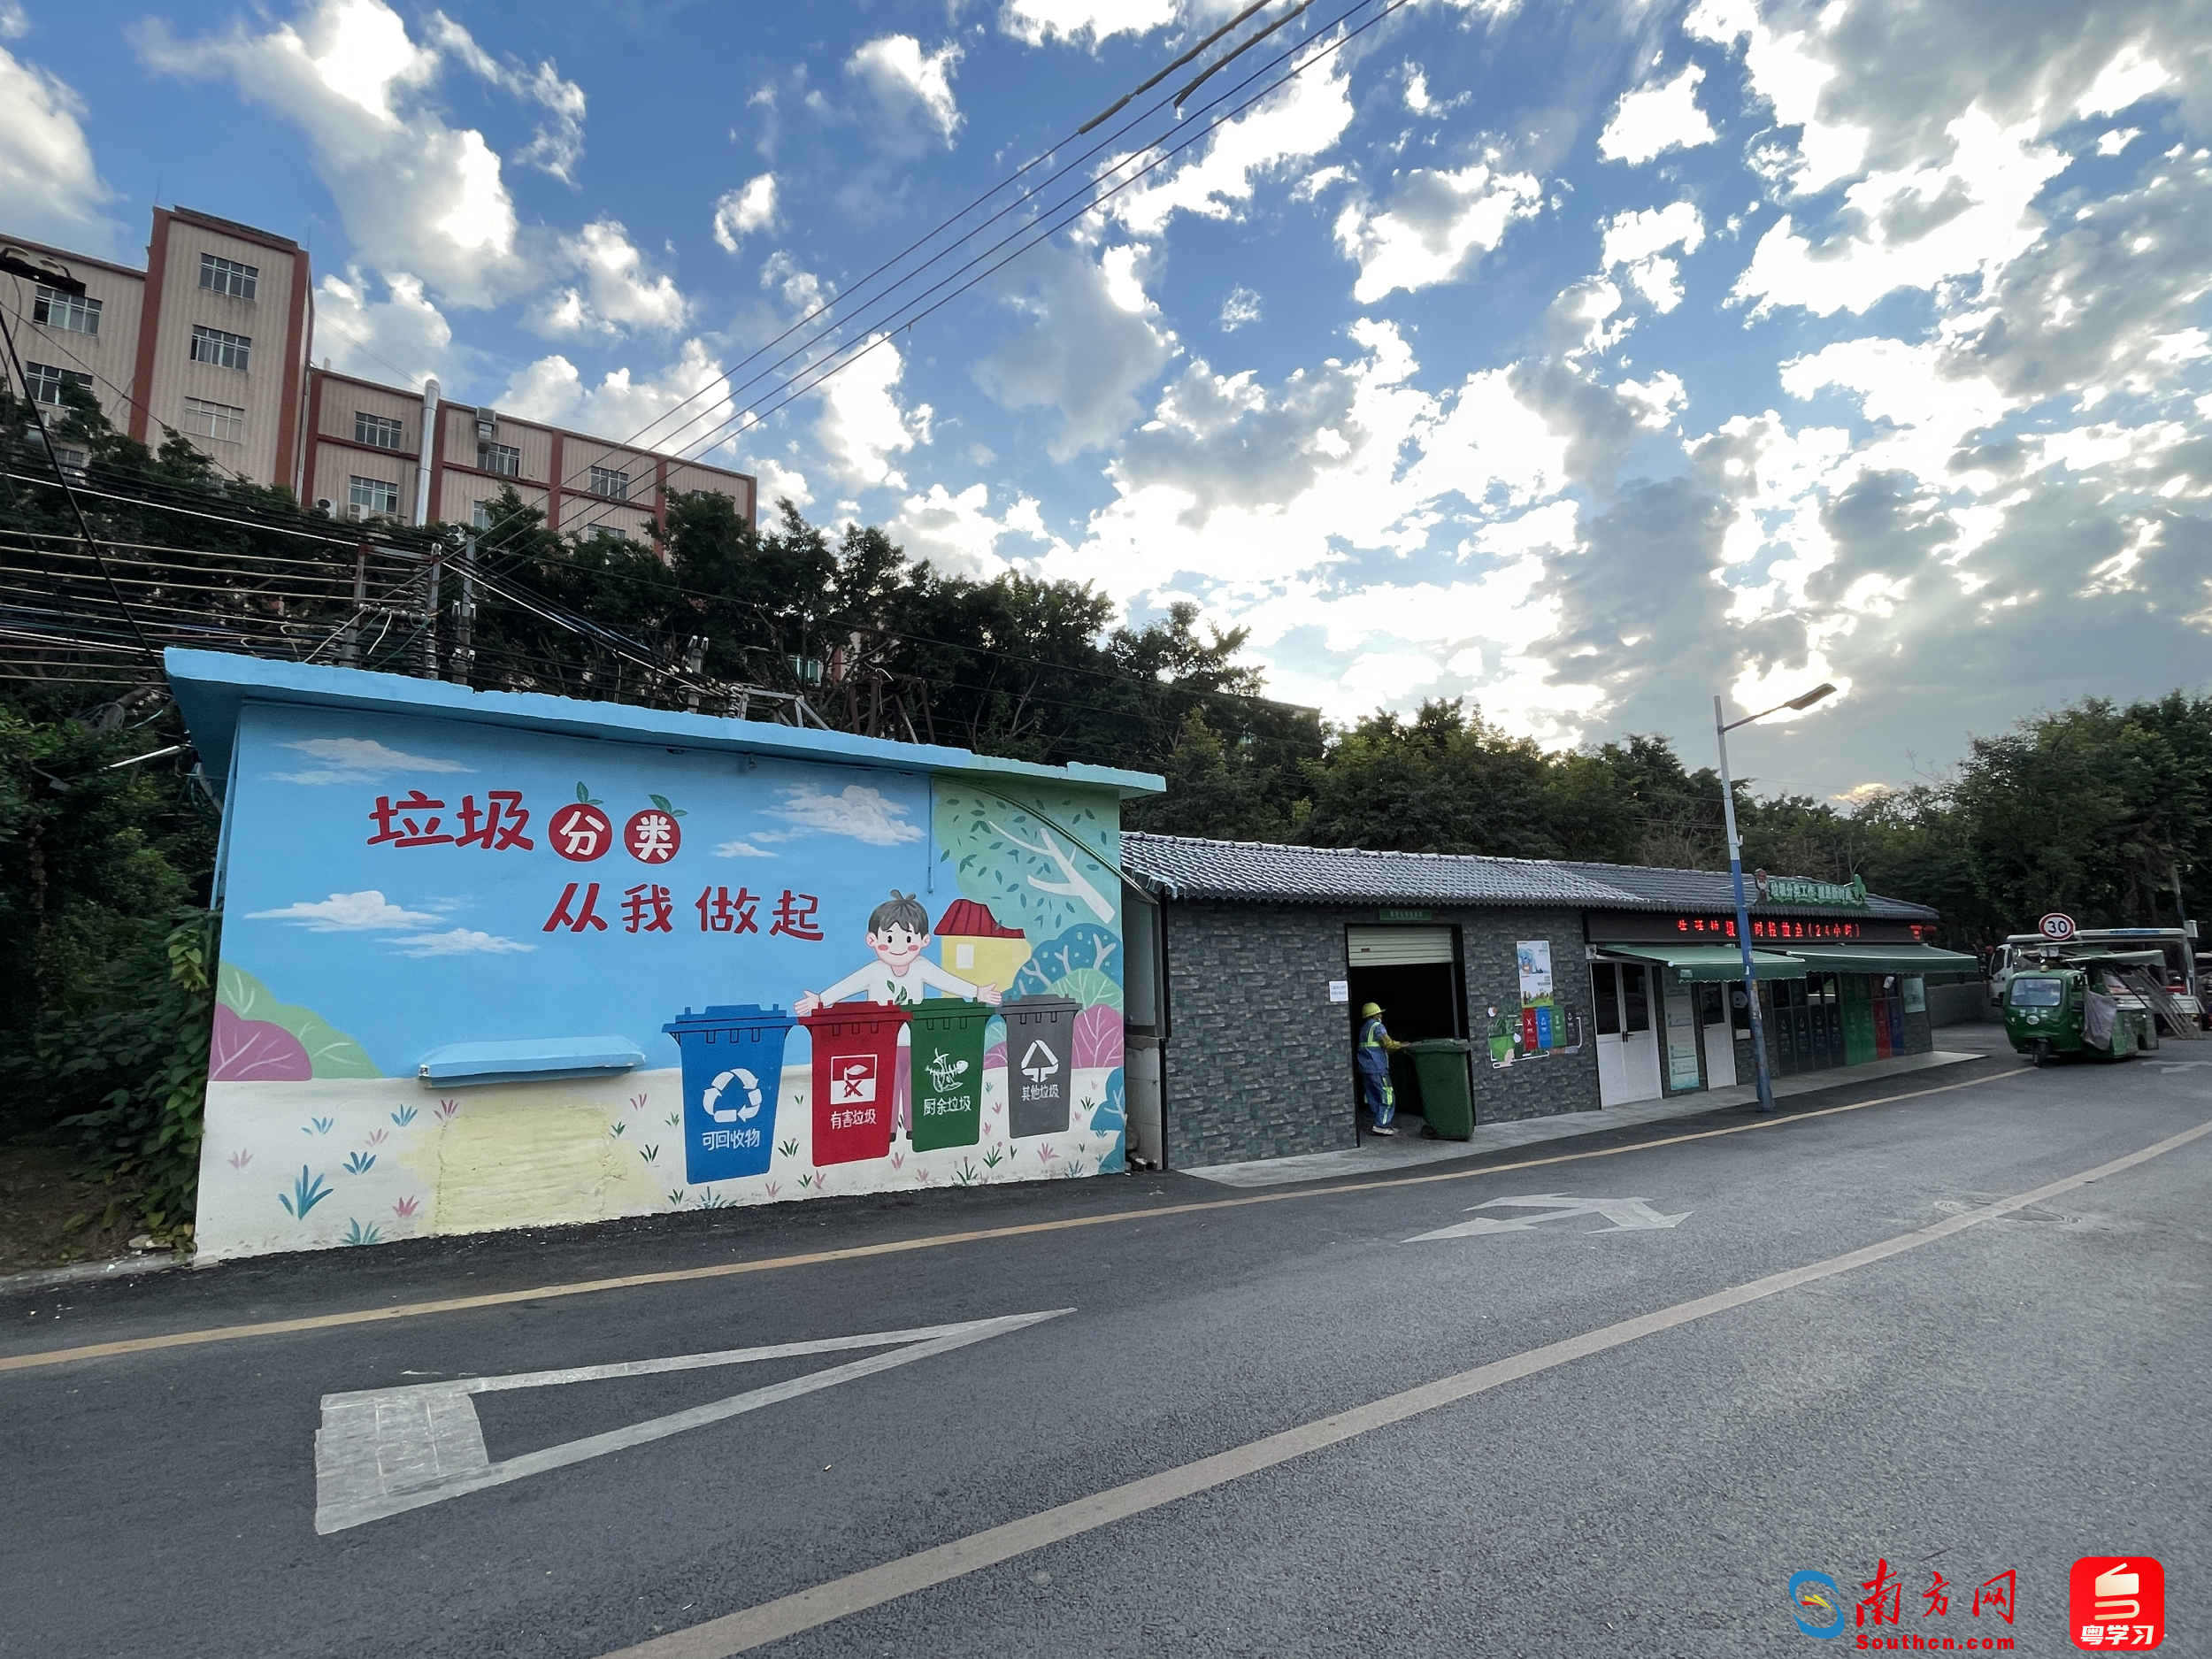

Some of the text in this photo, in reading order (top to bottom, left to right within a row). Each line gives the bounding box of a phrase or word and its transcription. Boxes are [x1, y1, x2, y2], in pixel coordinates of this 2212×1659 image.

[367, 789, 673, 861] 垃圾分类
[542, 882, 825, 941] 从我做起
[2047, 920, 2068, 934] 30
[1021, 1083, 1061, 1102] 其他垃圾
[923, 1094, 972, 1117] 厨余垃圾
[830, 1109, 878, 1130] 有害垃圾
[702, 1127, 761, 1150] 可回收物
